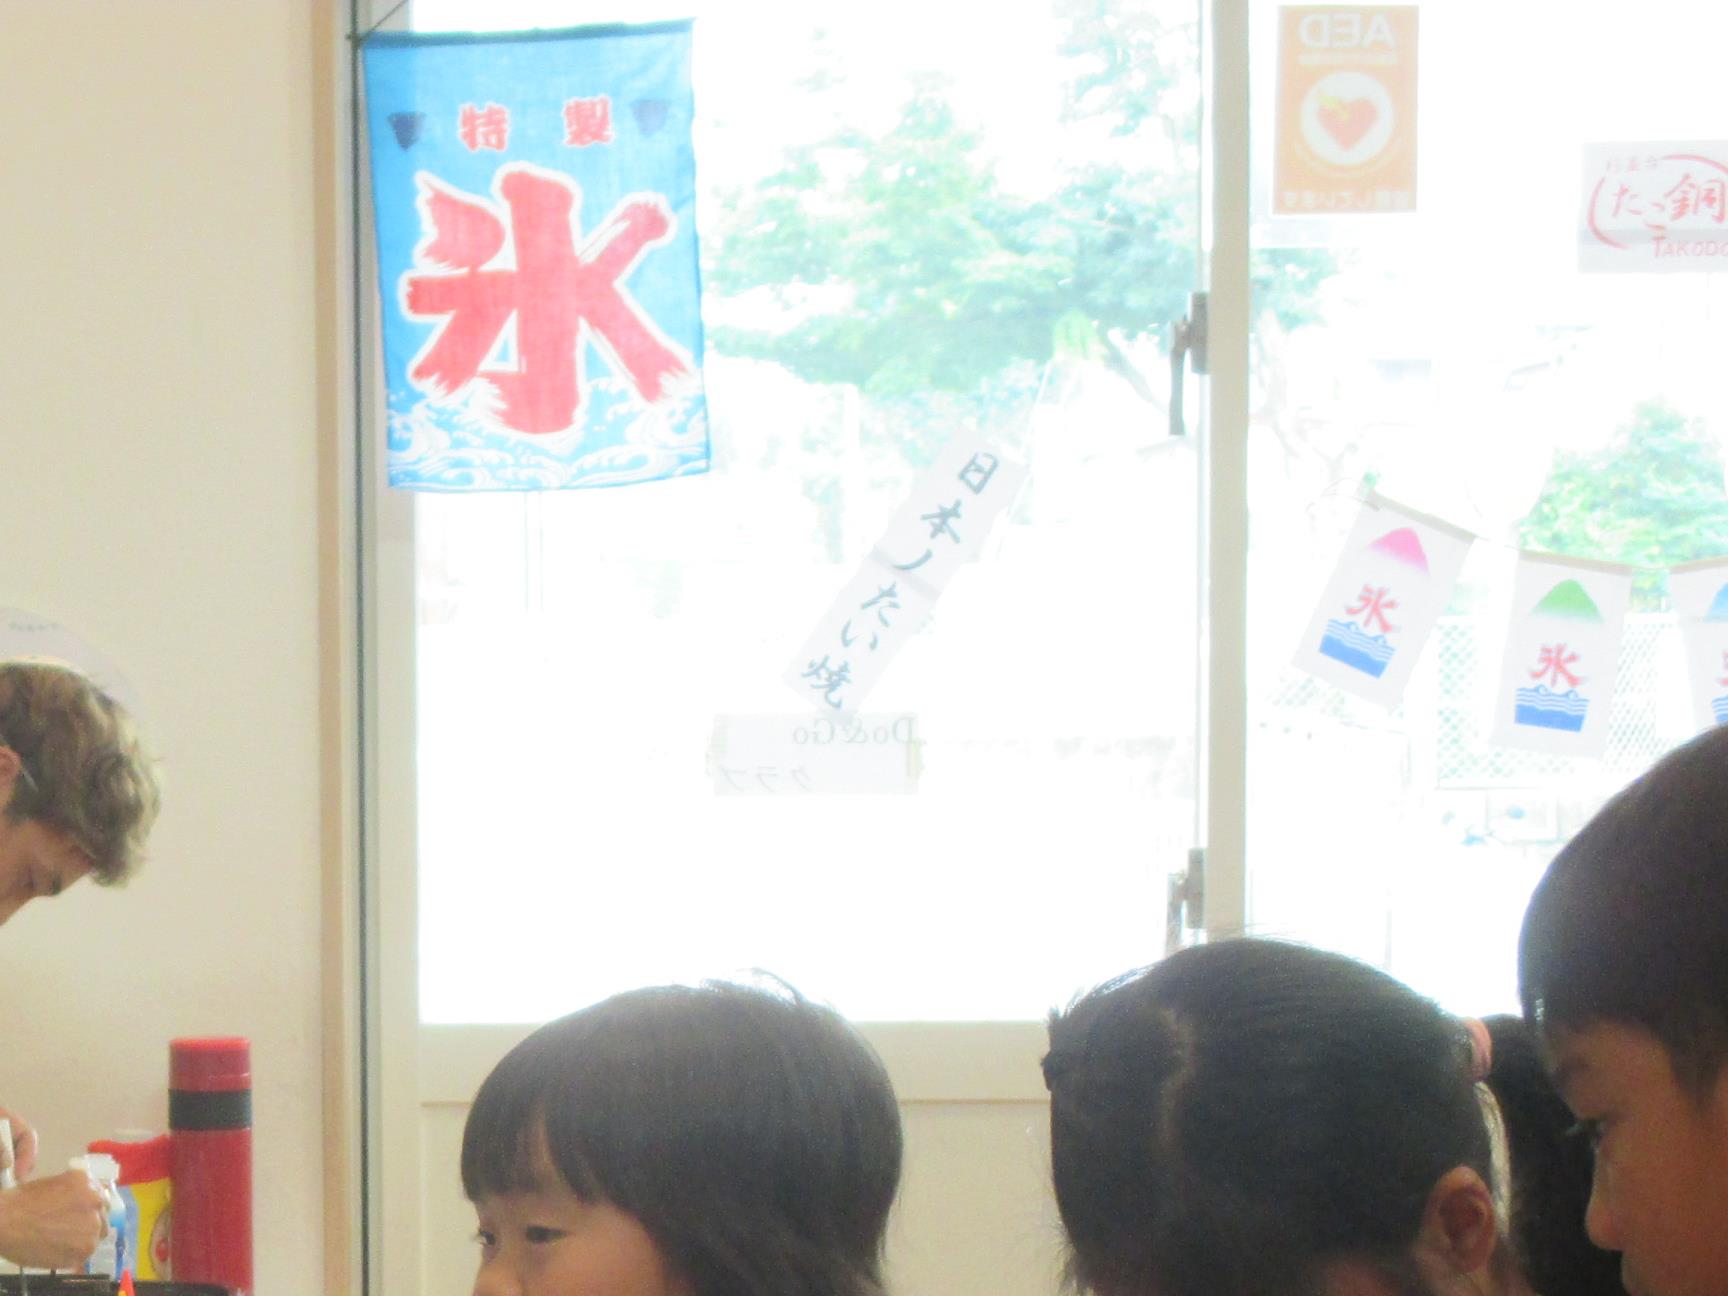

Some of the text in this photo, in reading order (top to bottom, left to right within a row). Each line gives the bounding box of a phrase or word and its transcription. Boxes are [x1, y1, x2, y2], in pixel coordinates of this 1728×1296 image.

[459, 96, 613, 150] 特製
[402, 166, 690, 436] 氷
[1345, 584, 1399, 634] 氷
[1530, 643, 1585, 687] 氷
